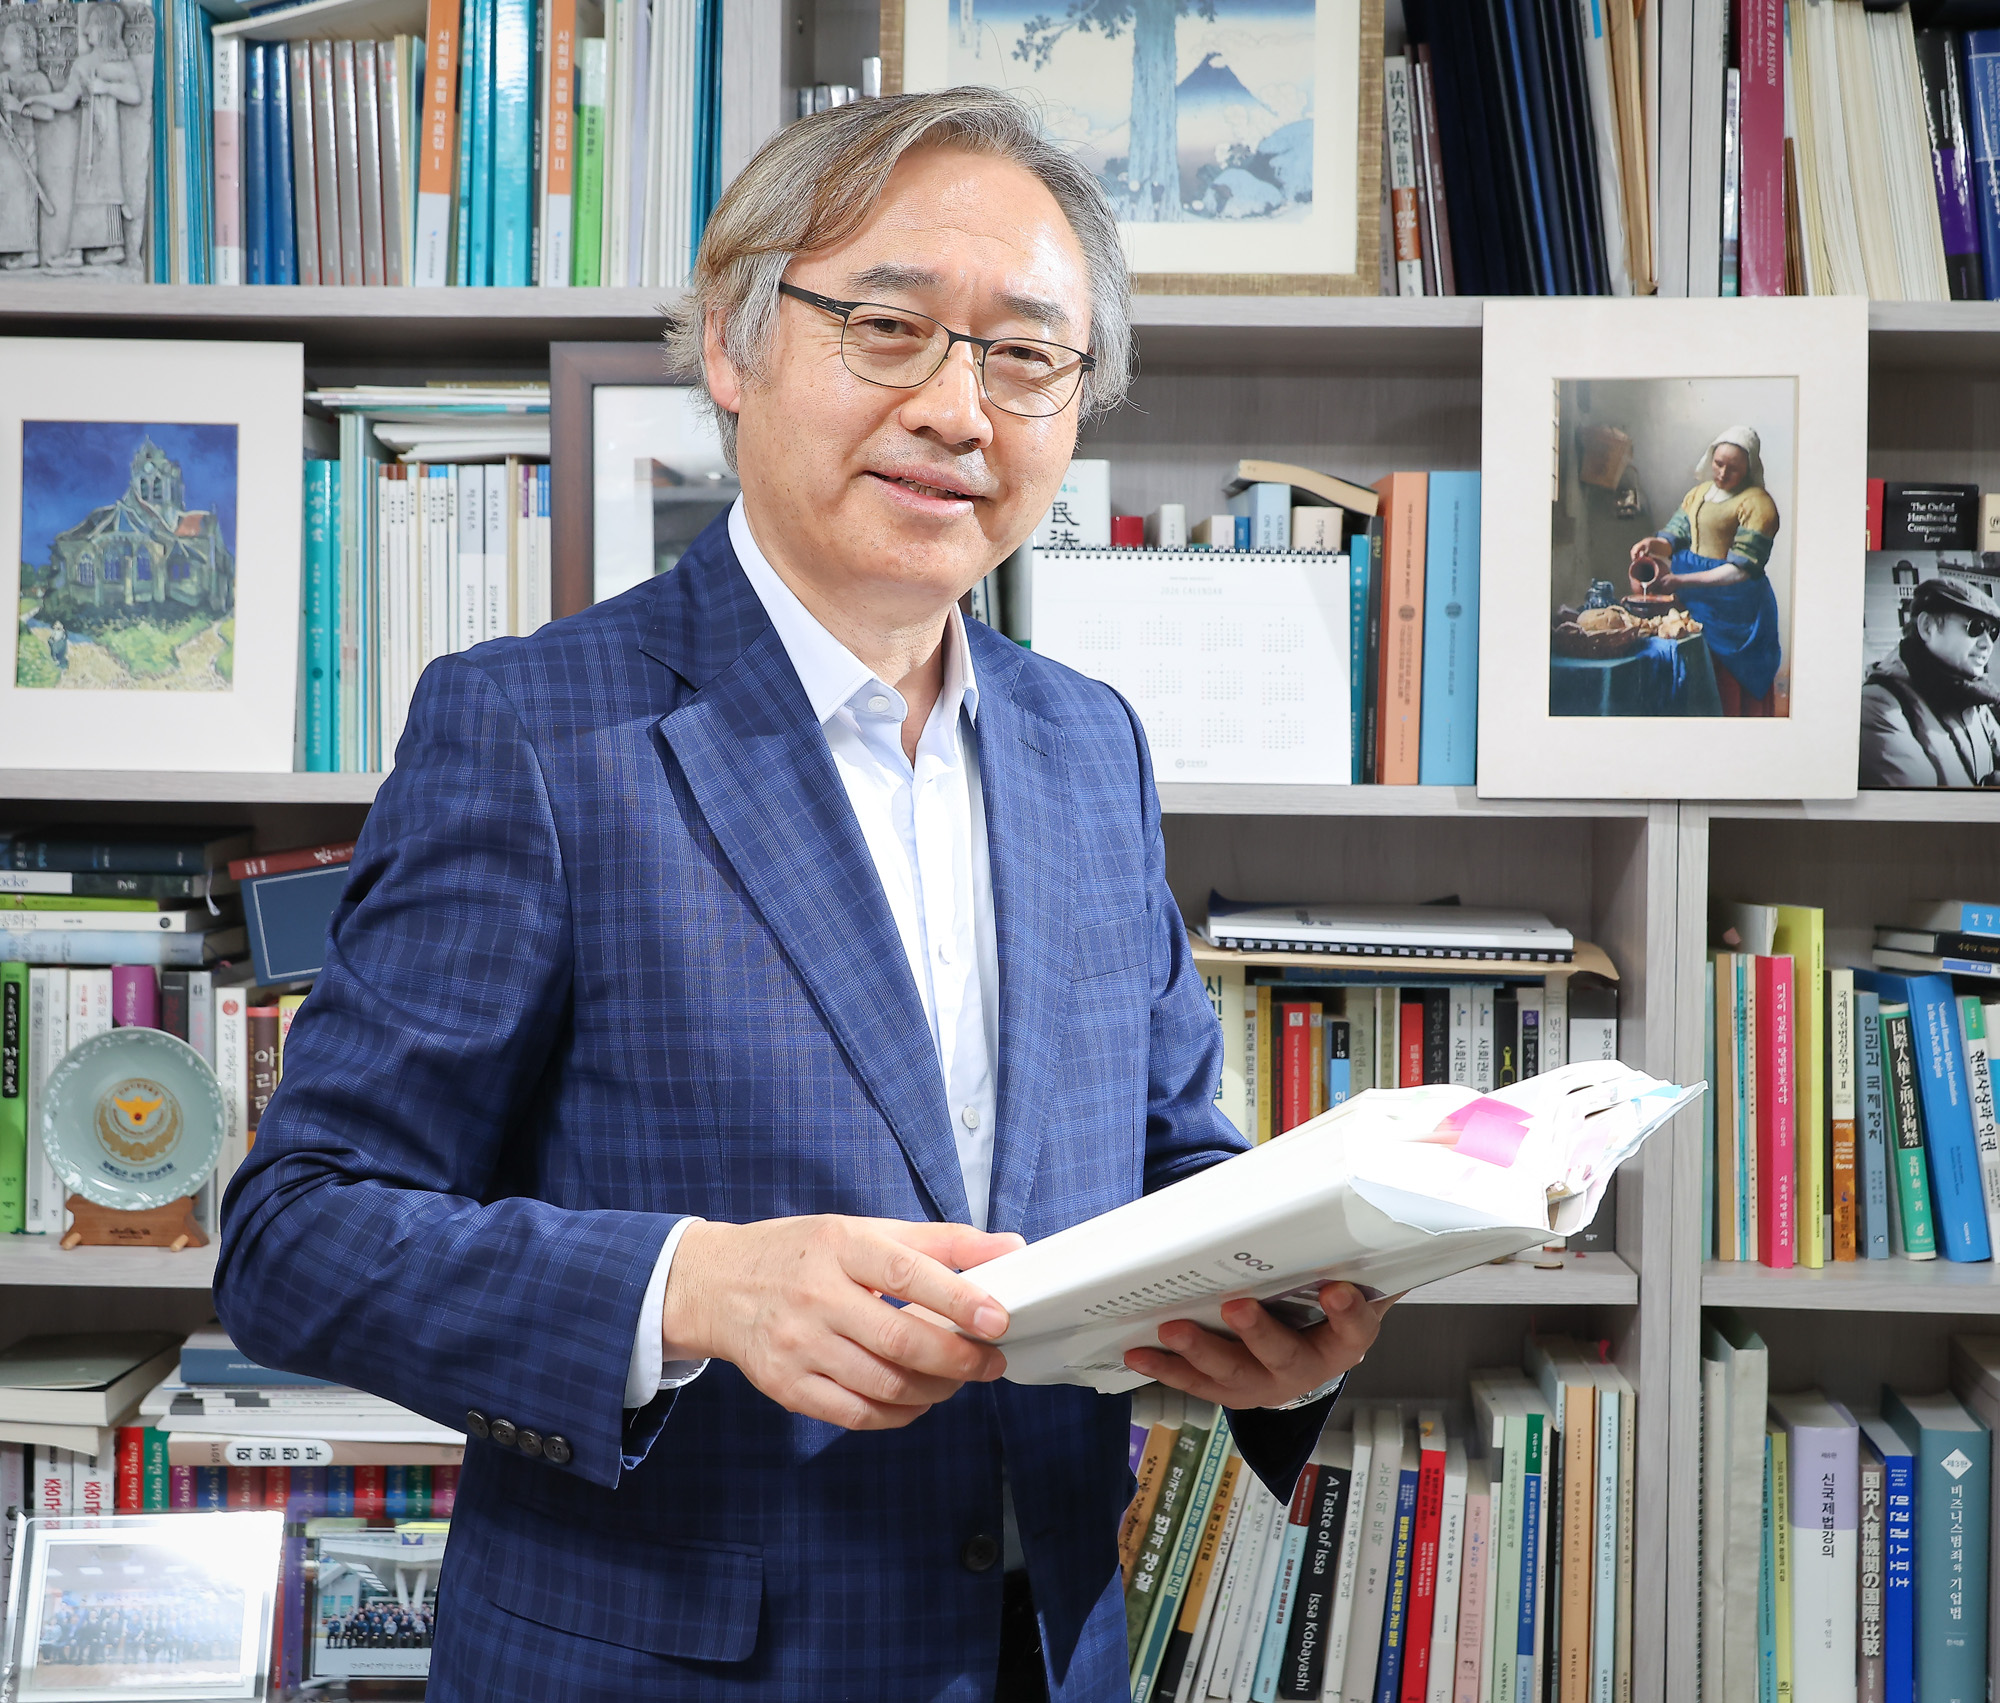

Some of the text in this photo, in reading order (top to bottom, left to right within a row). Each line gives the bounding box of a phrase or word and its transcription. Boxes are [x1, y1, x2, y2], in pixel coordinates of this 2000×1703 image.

[1766, 31, 1777, 87] PASSION
[1907, 513, 1958, 523] Handbook of
[1907, 523, 1957, 533] Comparative
[1911, 502, 1955, 512] The Oxford
[1924, 534, 1941, 543] Law
[1777, 982, 1787, 1013] 이것이
[1864, 1016, 1883, 1144] 인권과 국제정치
[1970, 1048, 1997, 1151] 현대사상과 인권
[1780, 1175, 1788, 1247] 서울지방변호사회
[236, 1446, 323, 1461] 회원명부
[1531, 1432, 1539, 1459] 2019
[1374, 1461, 1392, 1516] 노모스의
[1821, 1472, 1836, 1559] 신국제법강의
[1149, 1514, 1171, 1548] 법과
[1312, 1475, 1340, 1575] A Taste of Issa
[1950, 1485, 1963, 1620] 비즈니스범죄와 기업법
[1135, 1551, 1160, 1593] 생활
[1861, 1471, 1881, 1657] 国内人権機関の国際比較
[1295, 1592, 1323, 1692] Issa Kobayashi
